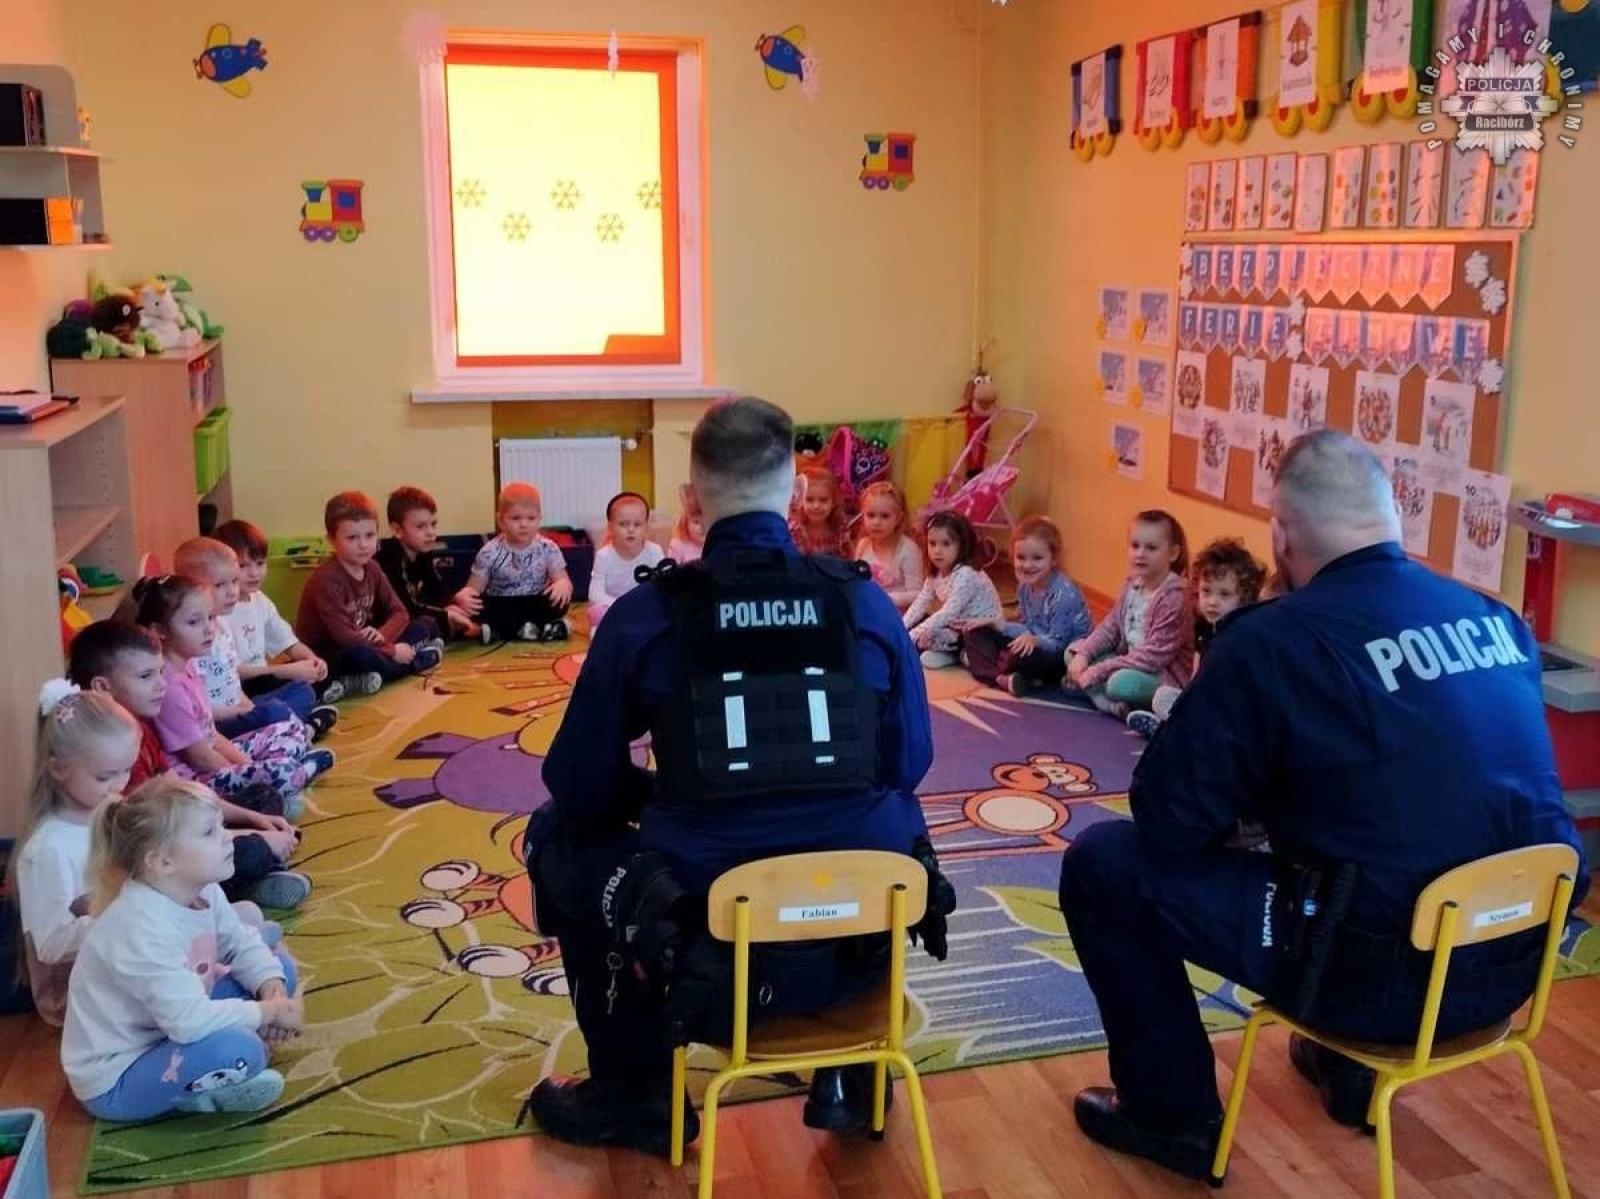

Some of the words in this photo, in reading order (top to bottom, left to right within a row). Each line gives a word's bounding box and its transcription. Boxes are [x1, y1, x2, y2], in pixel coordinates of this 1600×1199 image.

[1183, 308, 1281, 341] FERIE
[719, 599, 818, 629] POLICJA
[1364, 615, 1528, 693] POLICJA
[801, 907, 838, 919] Fabian
